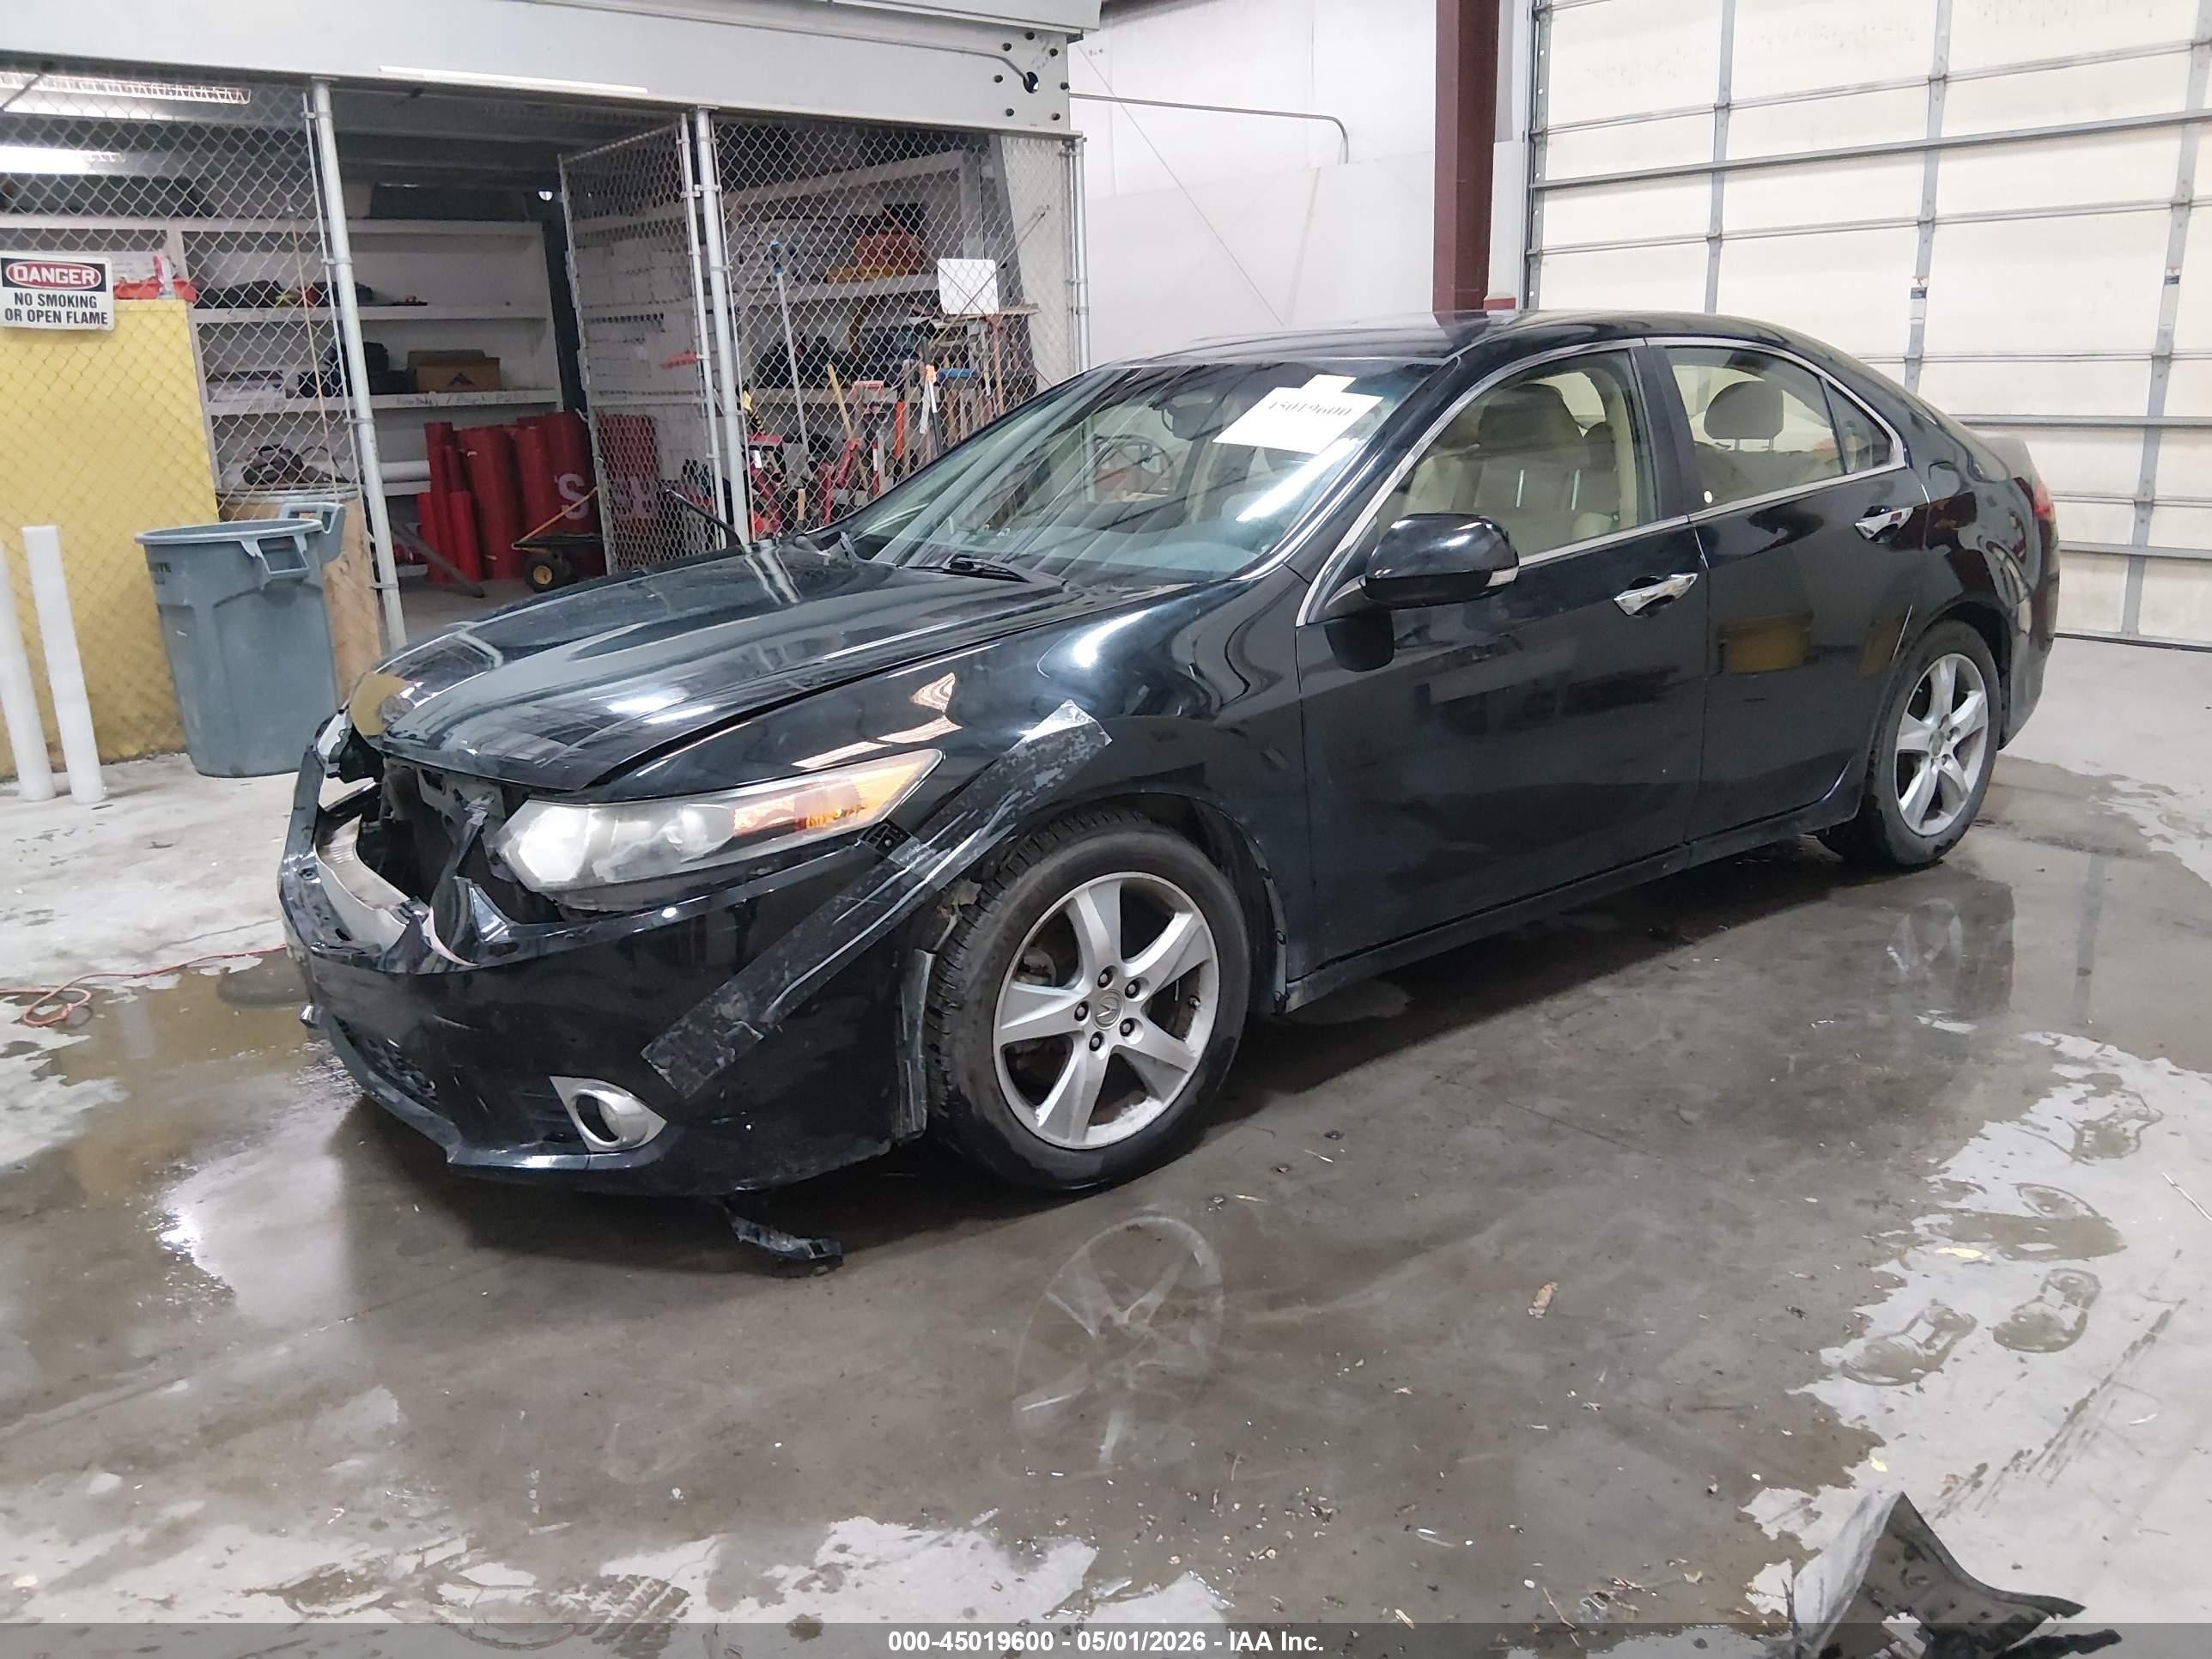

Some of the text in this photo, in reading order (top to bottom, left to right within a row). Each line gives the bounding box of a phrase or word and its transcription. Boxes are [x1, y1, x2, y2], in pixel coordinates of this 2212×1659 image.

[13, 266, 96, 284] DANGER
[15, 293, 97, 308] NO SMOKING
[5, 307, 108, 325] OR OPEN FLAME
